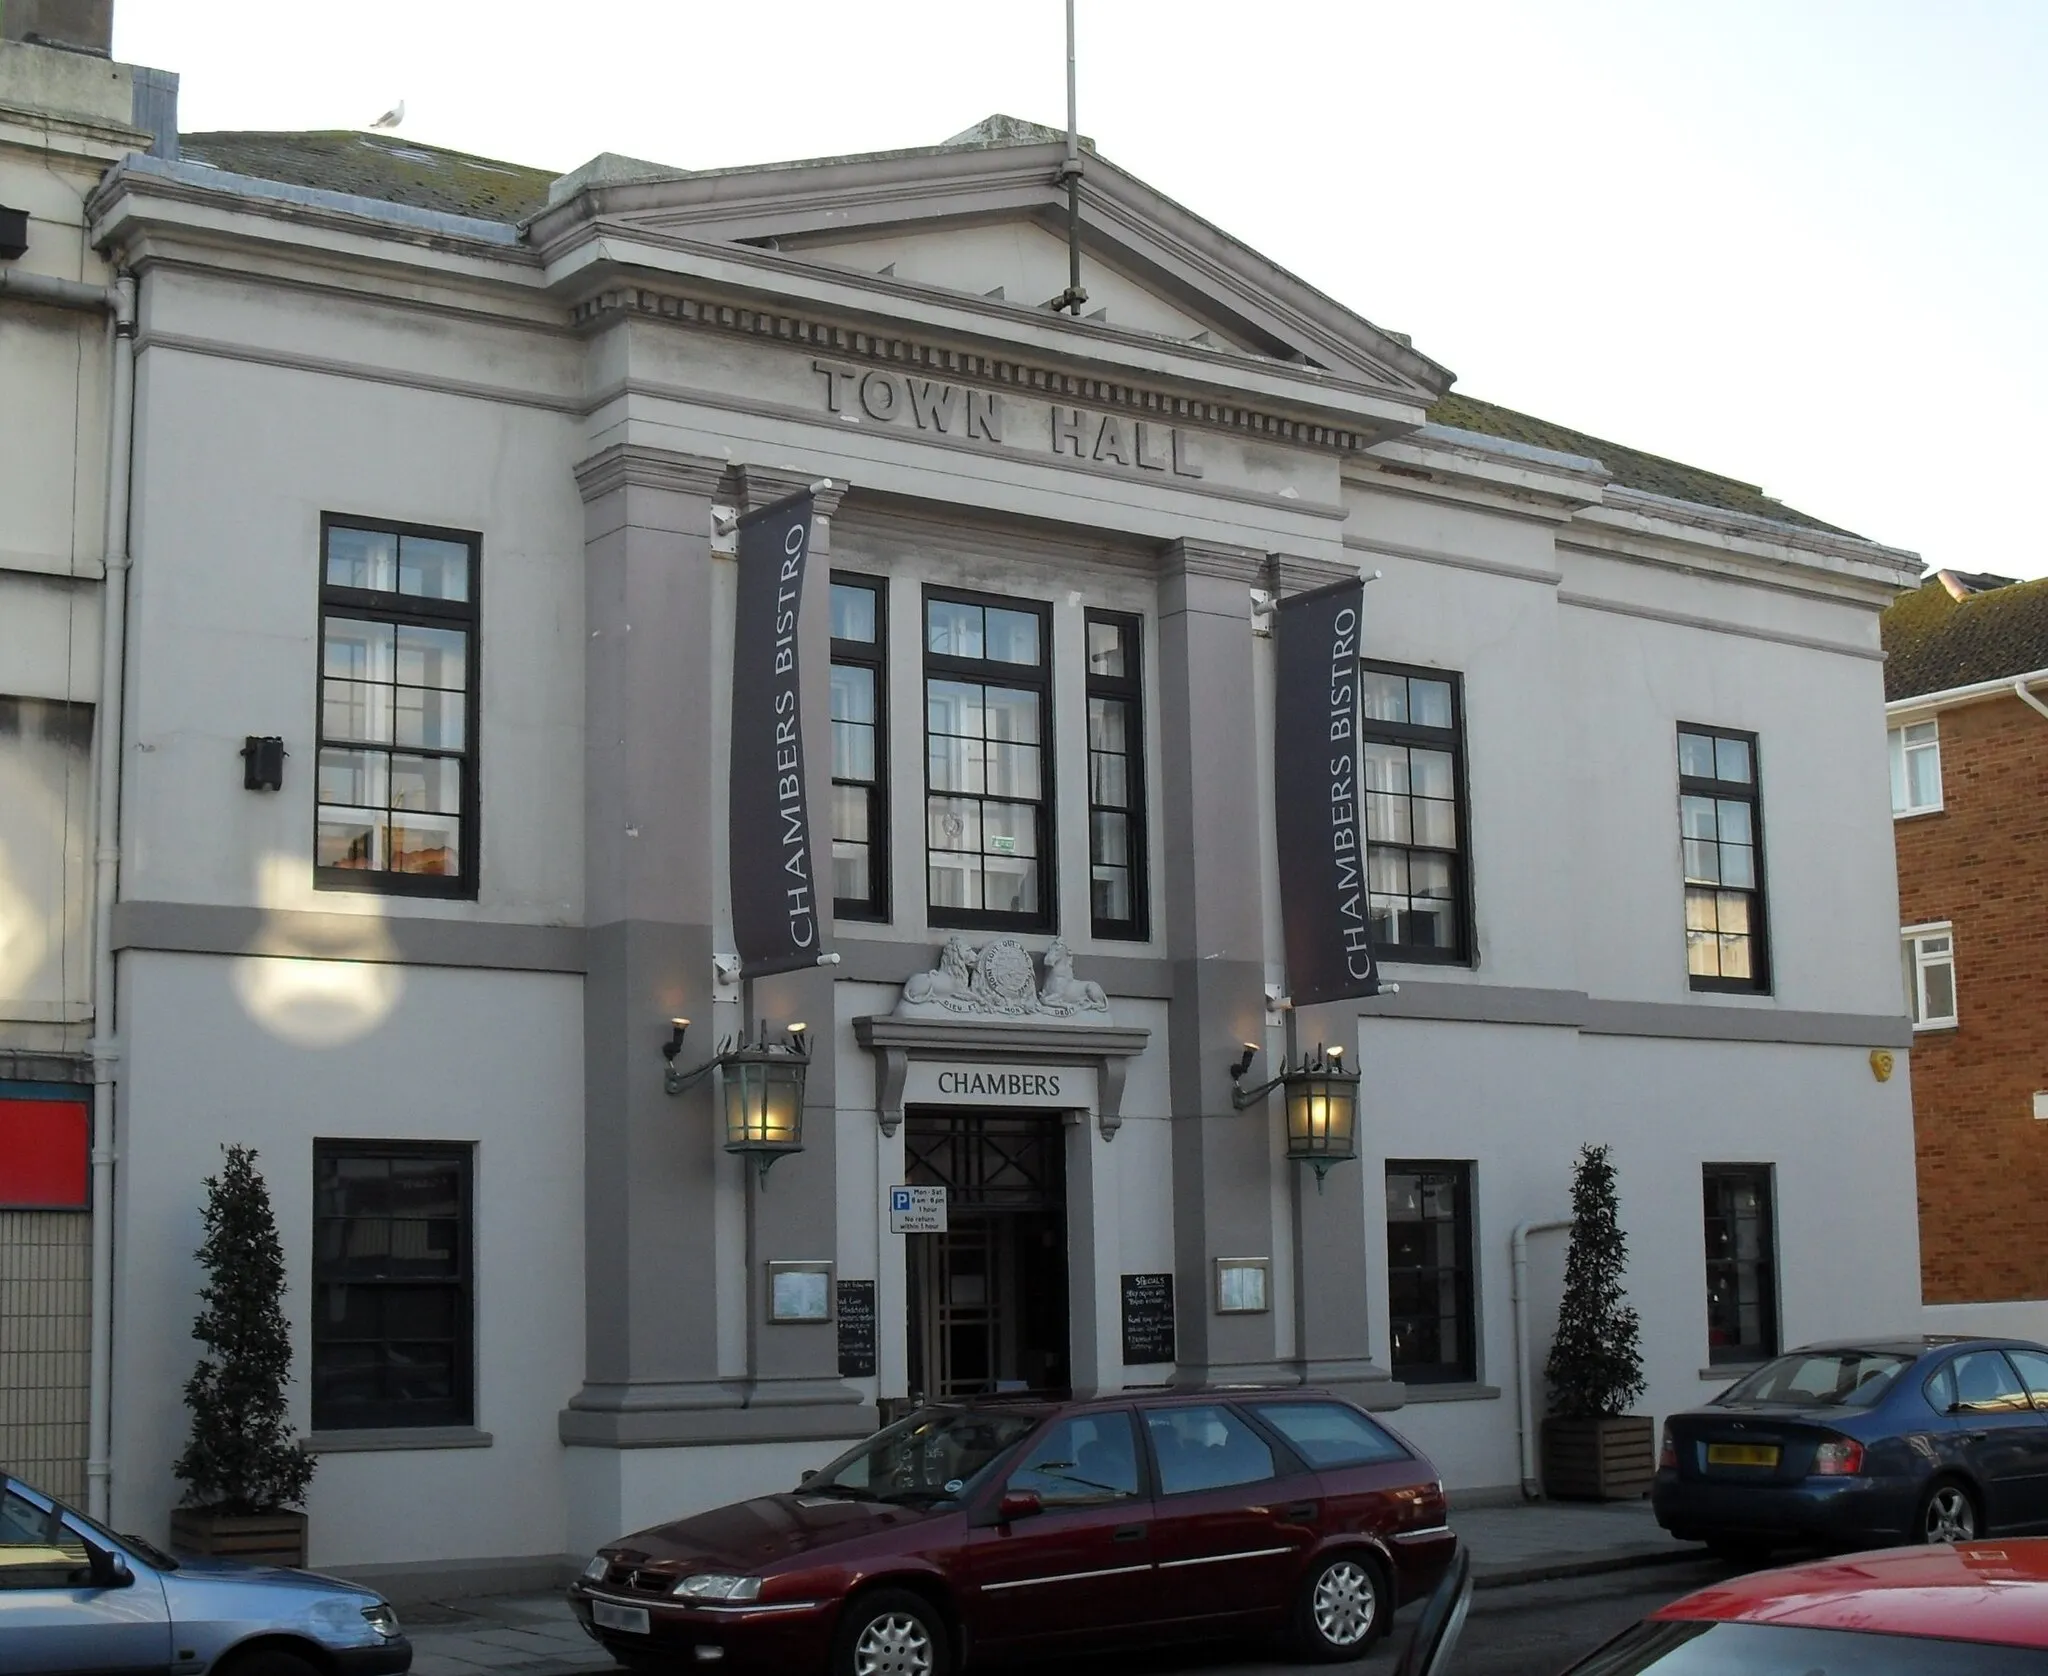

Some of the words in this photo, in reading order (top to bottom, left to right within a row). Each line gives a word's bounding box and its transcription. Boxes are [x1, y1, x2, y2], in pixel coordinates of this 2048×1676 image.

[813, 361, 1001, 442] TOWN
[1051, 405, 1203, 479] HALL
[775, 523, 804, 676] BISTRO
[1330, 607, 1356, 743] BISTRO
[774, 690, 813, 948] CHAMBERS
[1329, 754, 1371, 980] CHAMBERS
[943, 1000, 963, 1012] DIEU
[967, 1003, 977, 1011] ET
[1054, 1007, 1076, 1016] DROIT
[938, 1072, 1060, 1097] CHAMBERS
